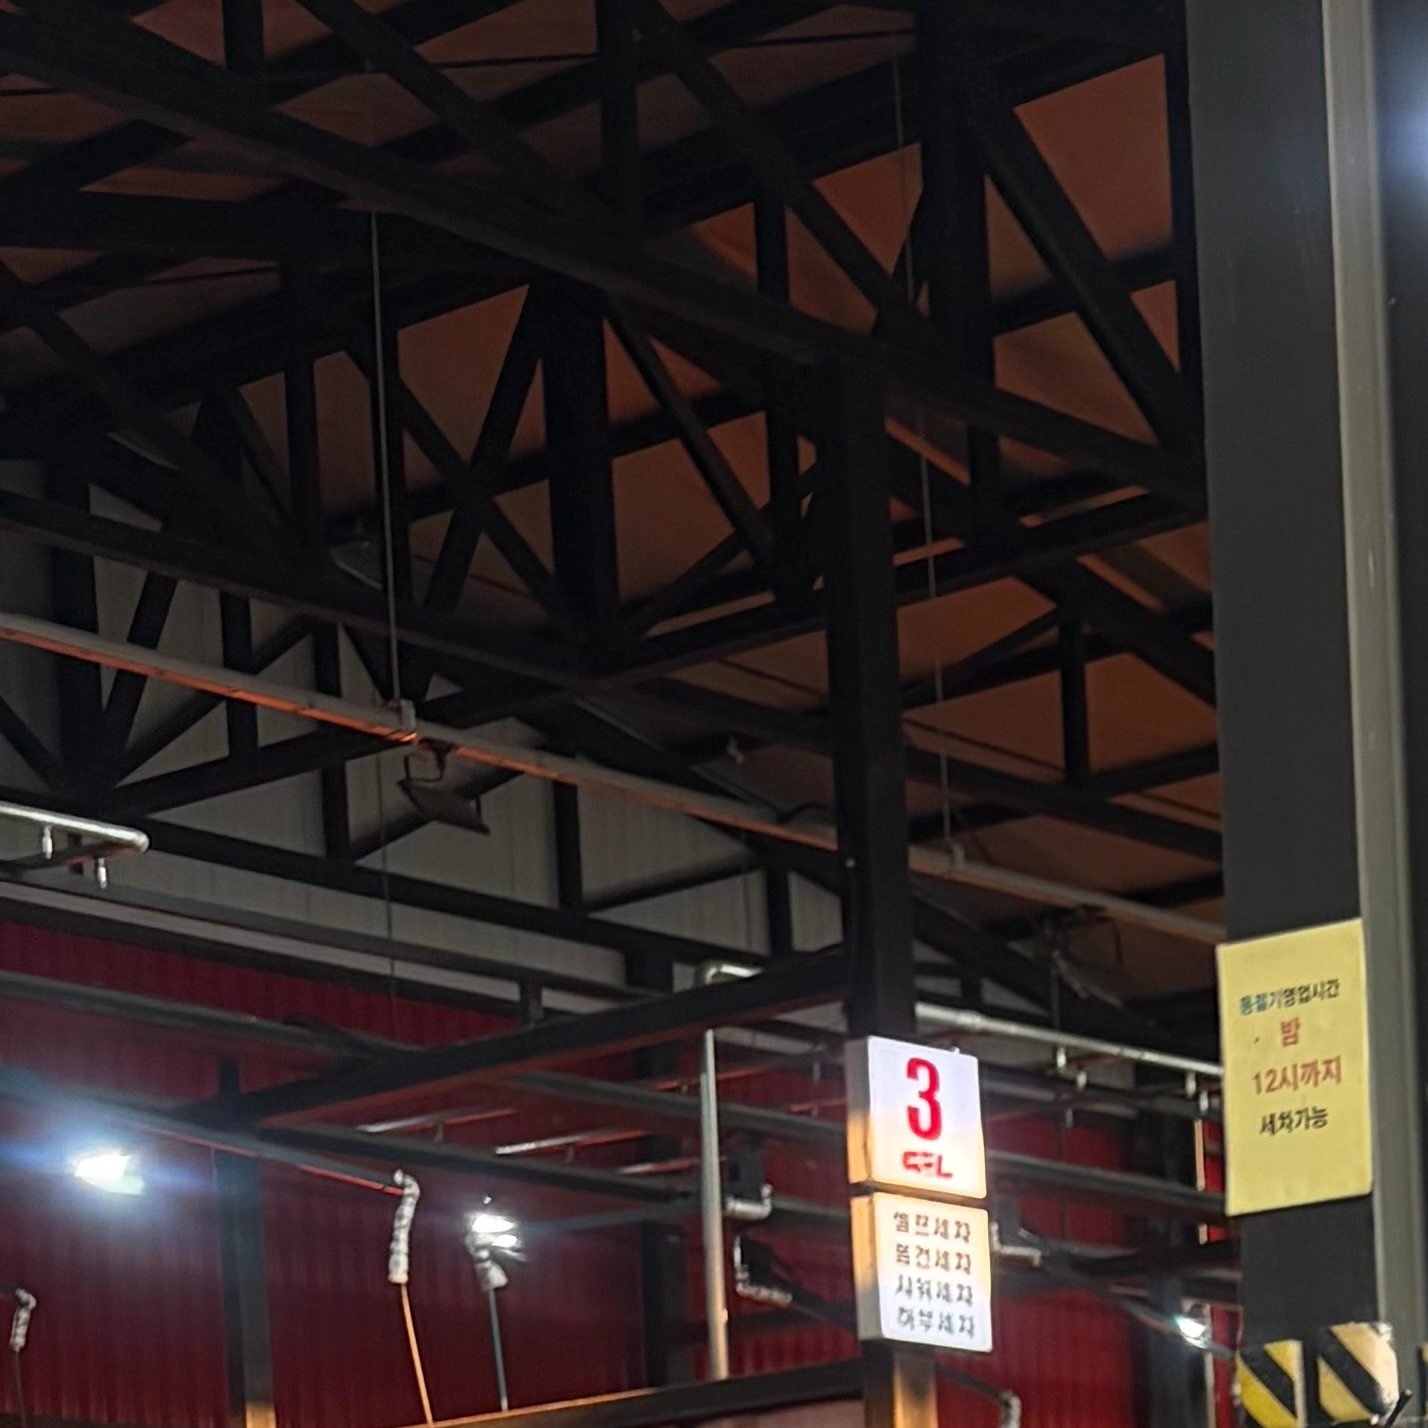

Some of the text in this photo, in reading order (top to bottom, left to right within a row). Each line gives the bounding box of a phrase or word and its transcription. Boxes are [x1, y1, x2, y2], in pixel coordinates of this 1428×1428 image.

[1280, 1016, 1300, 1049] 밤
[1253, 1054, 1342, 1095] 12시까지
[906, 1056, 943, 1141] 3
[1259, 1105, 1328, 1136] 세차가능
